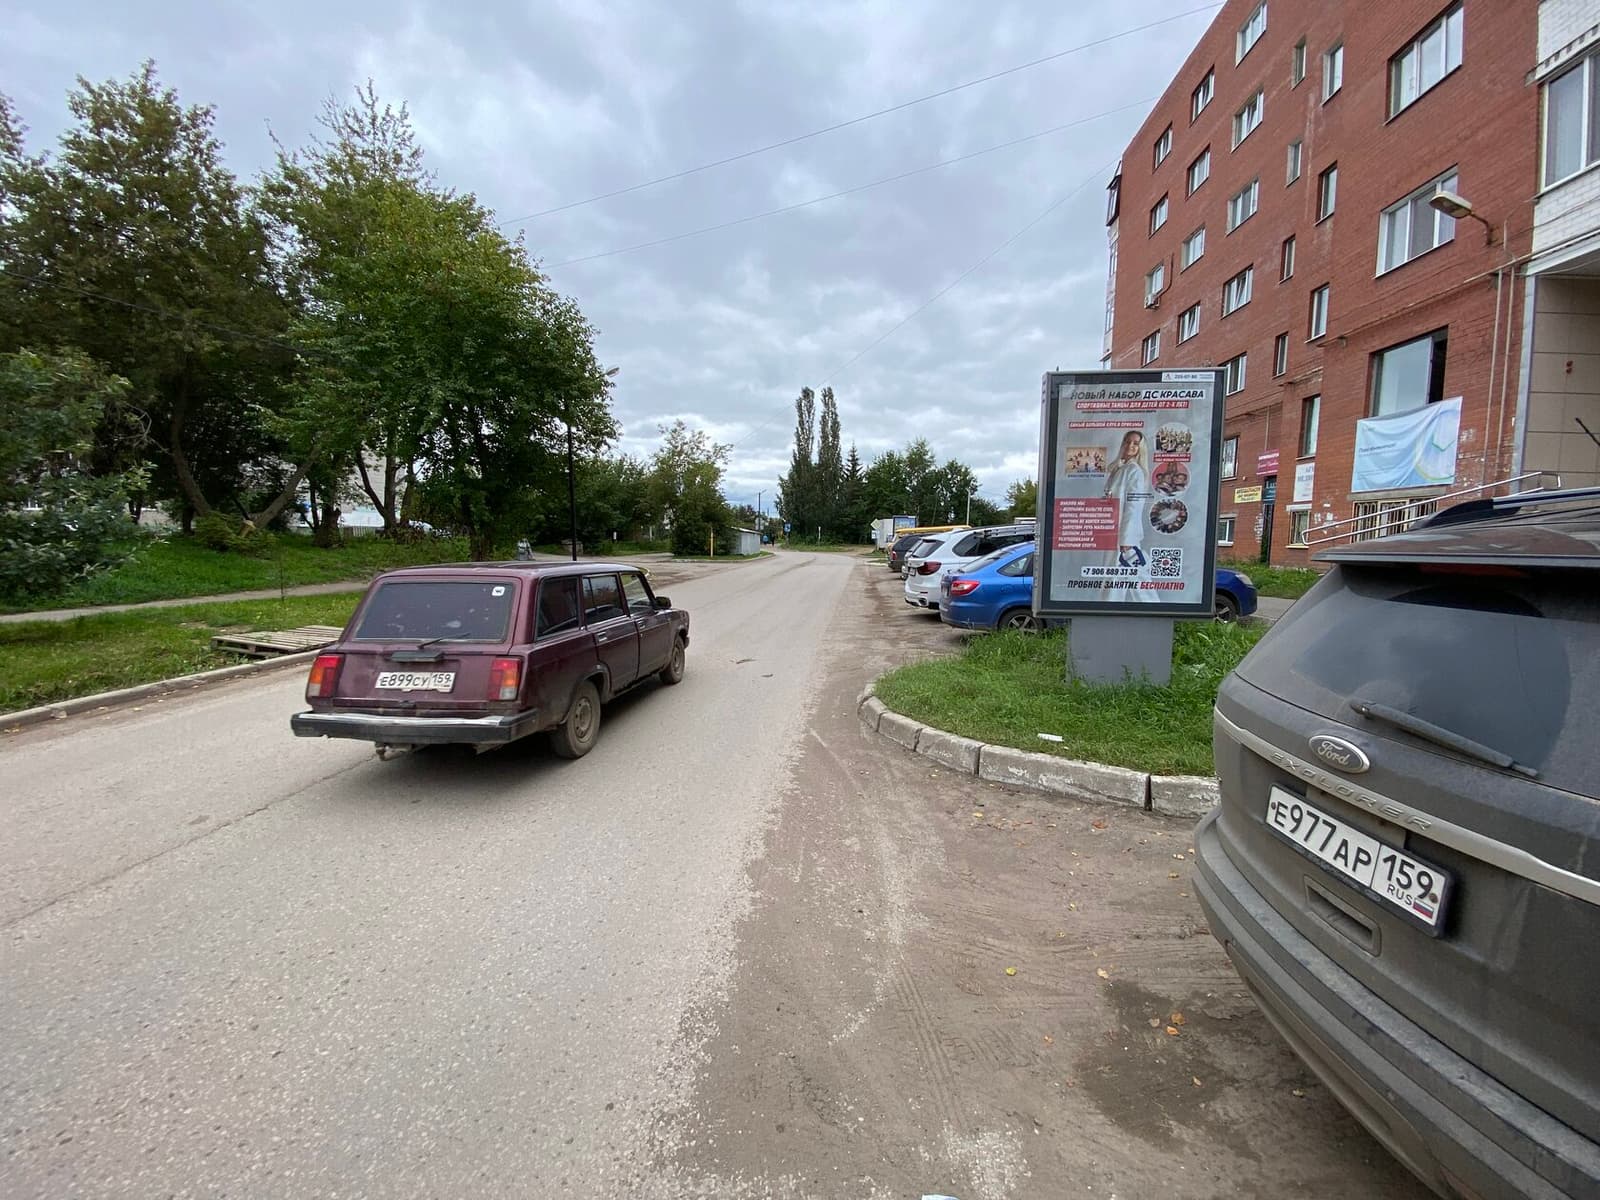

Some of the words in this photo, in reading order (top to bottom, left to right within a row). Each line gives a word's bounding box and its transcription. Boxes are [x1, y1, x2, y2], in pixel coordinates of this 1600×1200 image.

[1070, 389, 1106, 400] НОВЫЙ
[1108, 391, 1142, 399] НАБОР
[1143, 390, 1159, 399] ДС
[1160, 390, 1204, 399] КРАСАВА
[1083, 567, 1091, 575] +7
[1067, 580, 1103, 589] ПРОБНОЕ
[1104, 581, 1139, 590] ЗАНЯТИЕ
[1140, 581, 1185, 591] БЕСПЛАТНО
[432, 673, 450, 684] 159
[1317, 740, 1350, 766] Ford
[1382, 854, 1434, 900] 159
[1386, 884, 1413, 907] RUS
